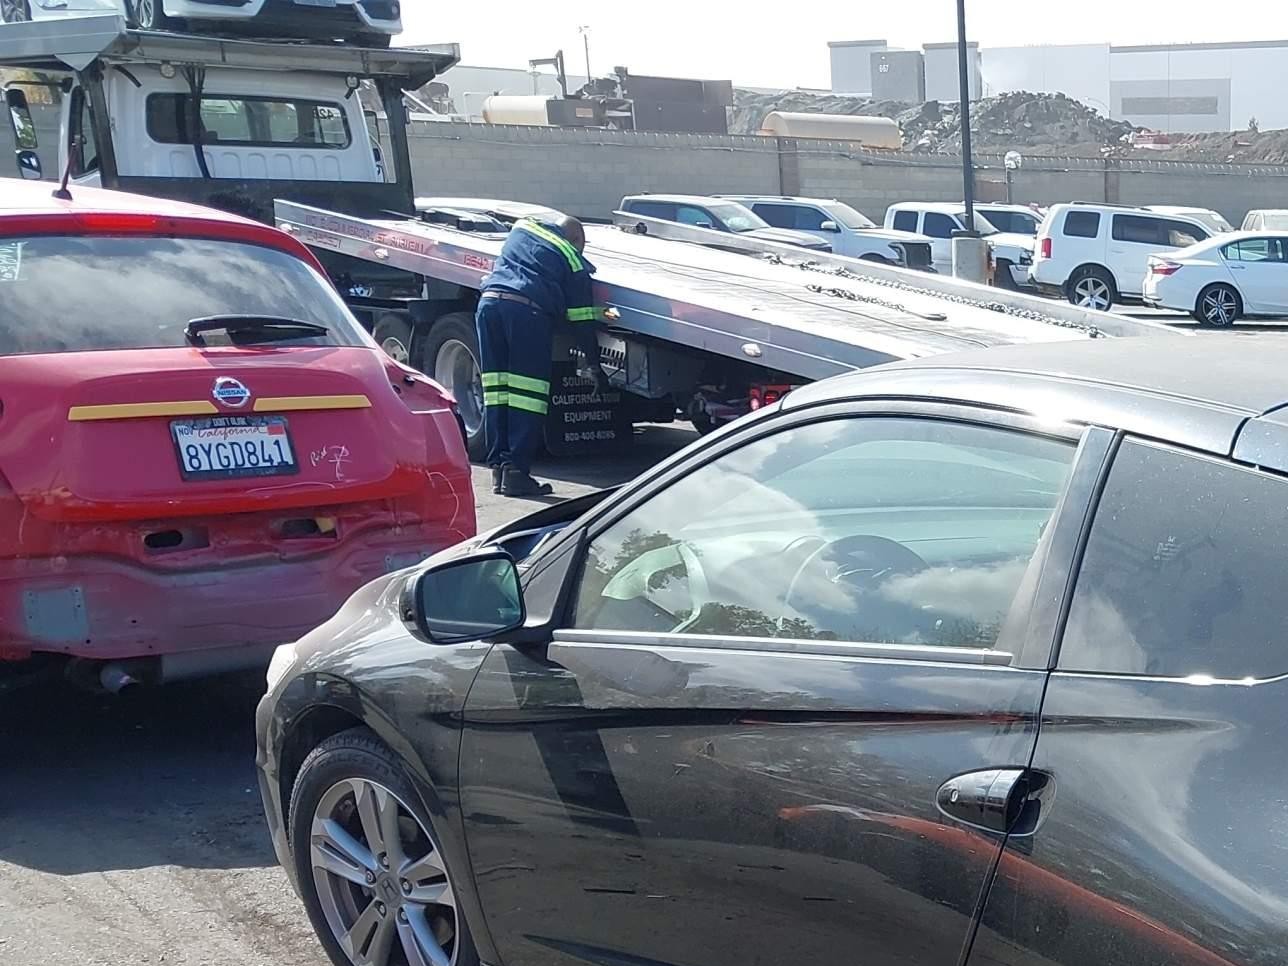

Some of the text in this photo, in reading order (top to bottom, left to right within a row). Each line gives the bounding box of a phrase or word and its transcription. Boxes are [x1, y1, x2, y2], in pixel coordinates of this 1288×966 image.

[217, 389, 247, 397] NISSAN
[564, 410, 612, 423] EQUIPMENT
[198, 426, 262, 440] California
[186, 439, 290, 470] 8YGD841
